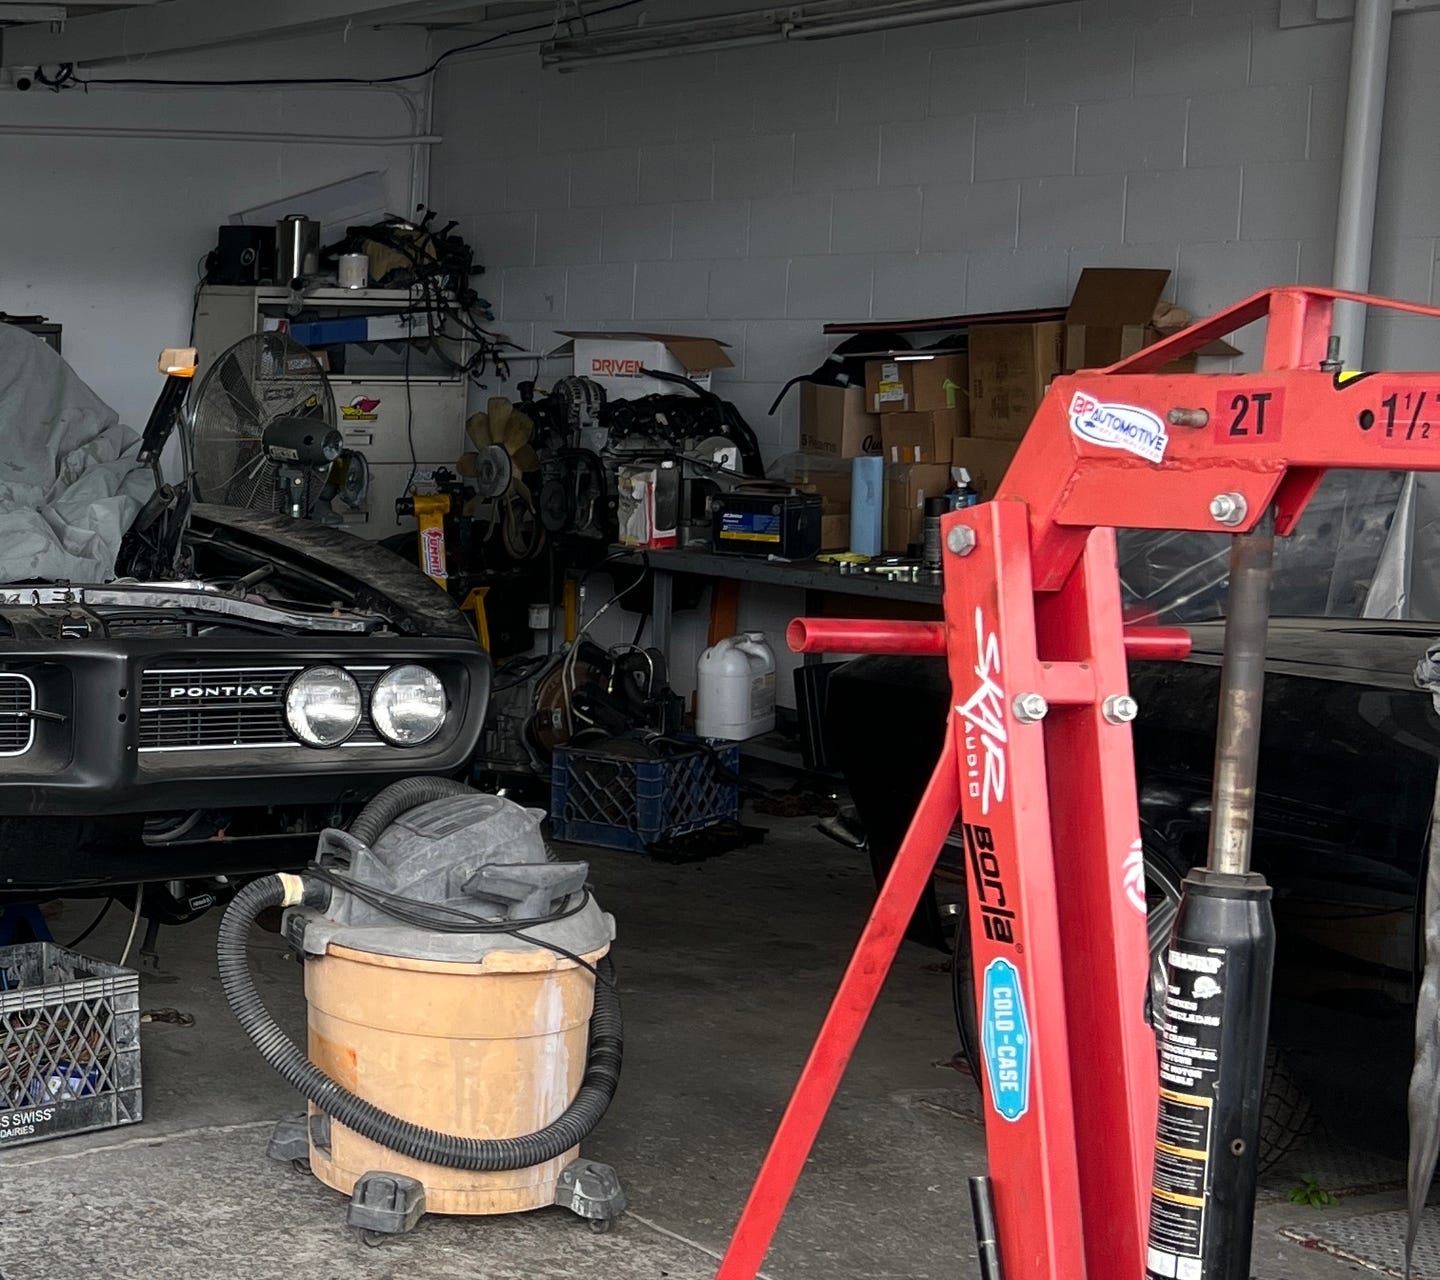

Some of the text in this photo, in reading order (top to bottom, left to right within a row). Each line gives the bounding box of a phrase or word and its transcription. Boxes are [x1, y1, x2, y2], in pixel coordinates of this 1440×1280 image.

[592, 359, 644, 377] DRIVEN
[1073, 395, 1165, 451] BP AUTOMOTIVE
[1230, 393, 1273, 436] 2T
[427, 531, 443, 573] SUMMIT
[170, 685, 274, 698] PONTIAC
[964, 720, 981, 798] AUDIO
[0, 1125, 35, 1138] DAIRIES
[12, 1110, 52, 1127] SWISS
